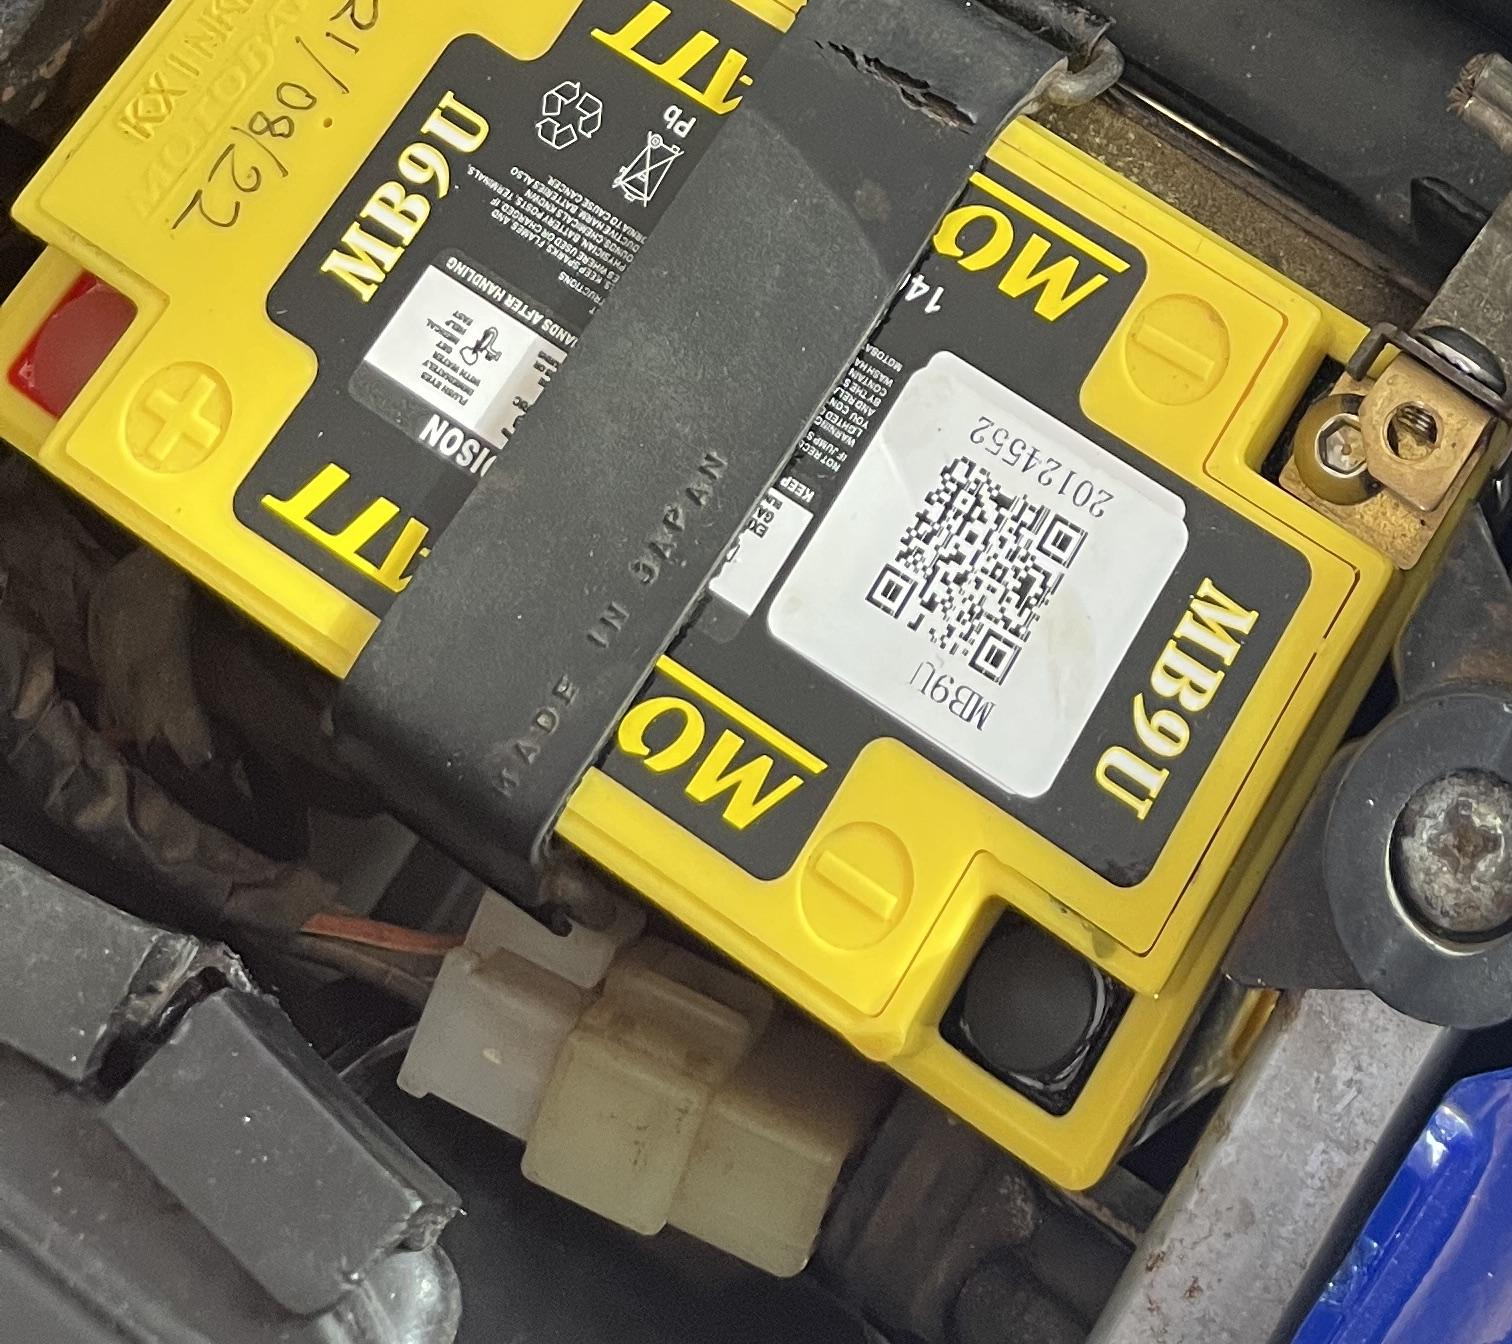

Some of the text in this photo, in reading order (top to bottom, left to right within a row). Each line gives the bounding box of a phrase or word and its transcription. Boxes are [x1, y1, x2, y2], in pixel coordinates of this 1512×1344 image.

[658, 102, 697, 138] Pb
[508, 165, 535, 186] ALSO
[320, 91, 489, 303] MB9U
[531, 179, 579, 214] BATTERIES
[580, 196, 612, 222] CAUSE
[489, 207, 511, 225] AND
[541, 212, 582, 243] BATTERY
[608, 215, 624, 229] TO
[552, 235, 579, 256] USED
[575, 249, 609, 275] WHERE
[447, 257, 505, 301] HANDLING
[504, 294, 543, 324] AFTER
[861, 340, 904, 372] MOTOBA
[865, 365, 894, 387] WASH
[848, 410, 870, 429] YOU
[853, 398, 876, 417] AND
[811, 433, 839, 456] JUMP
[818, 452, 842, 472] NOT
[968, 416, 1114, 518] 20124552
[778, 472, 815, 503] KEEP
[586, 602, 630, 650] IN
[908, 661, 996, 729] MB9U
[1094, 577, 1260, 820] MB9U
[617, 696, 805, 830] MO
